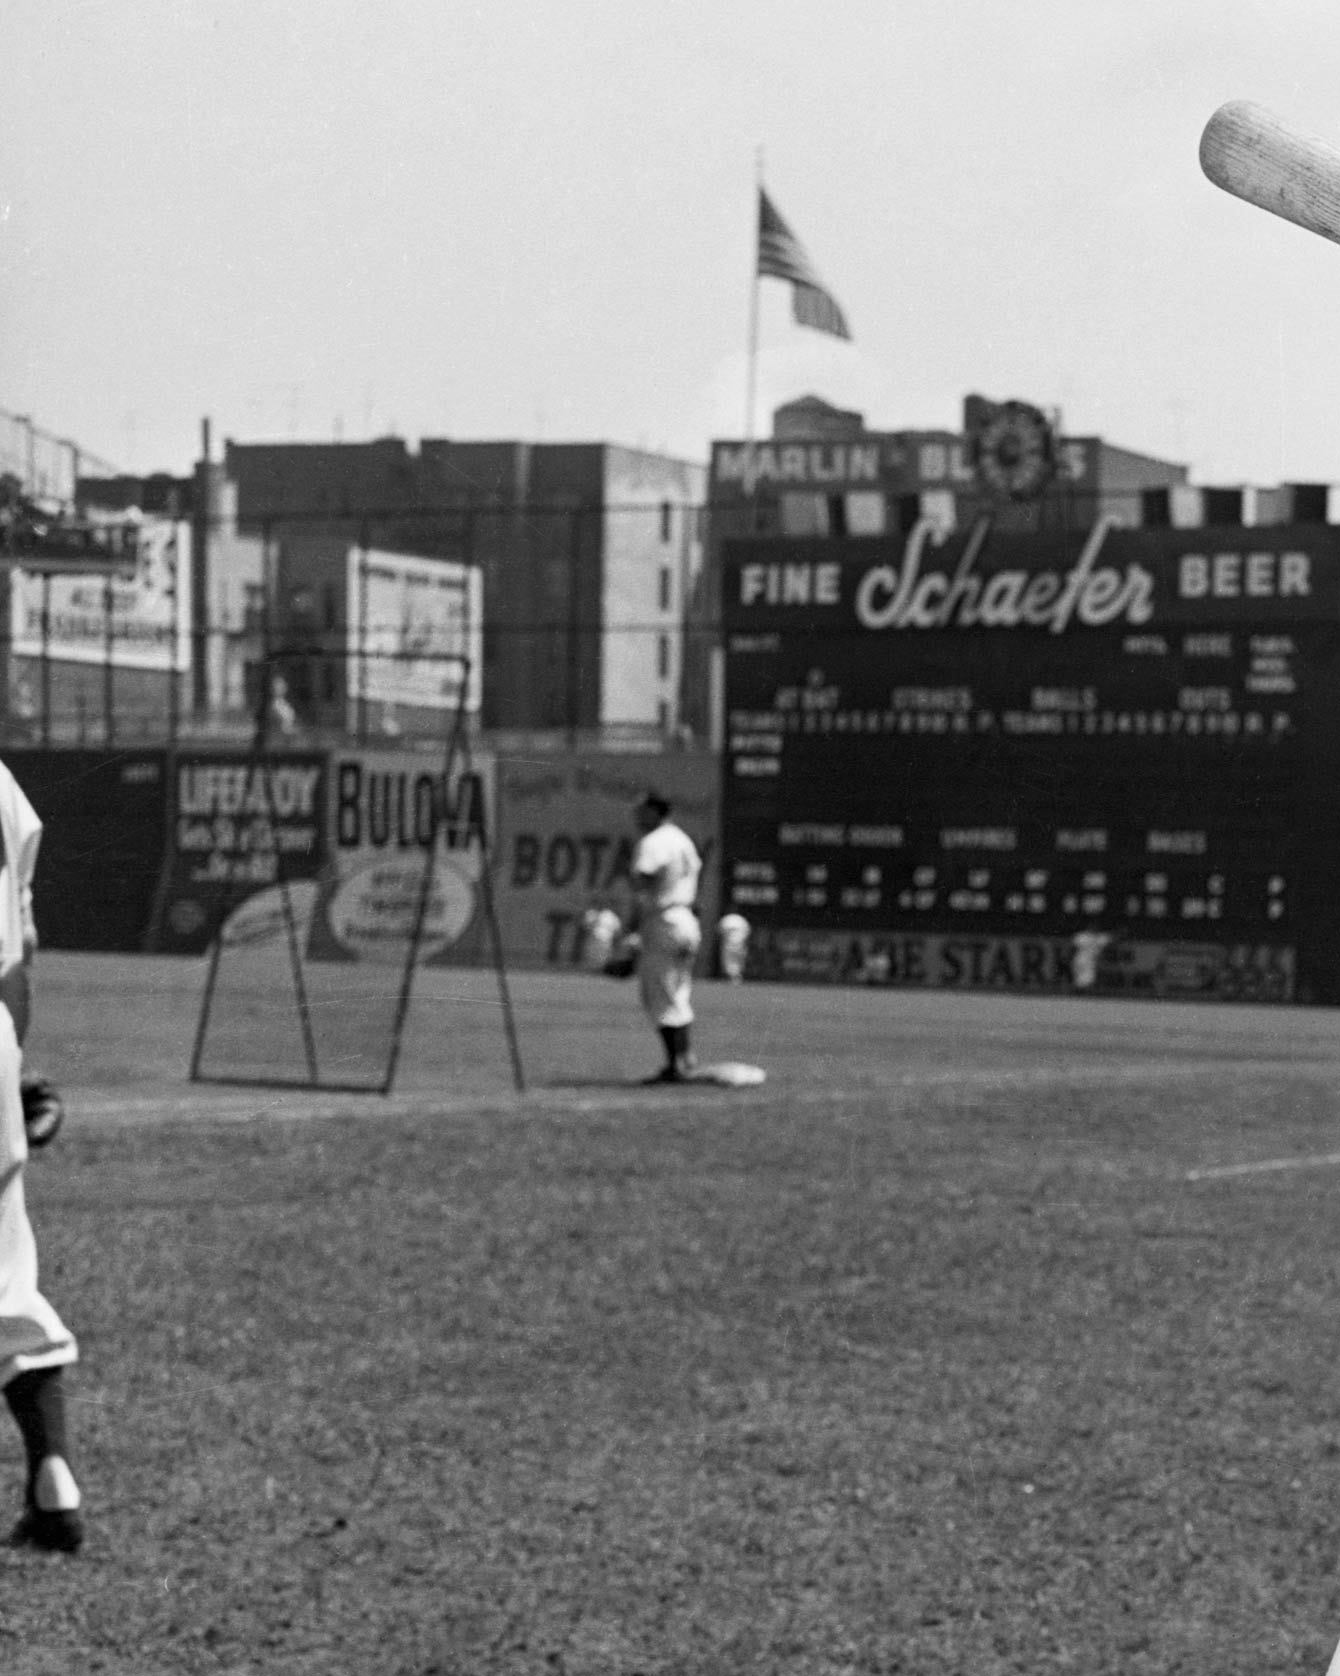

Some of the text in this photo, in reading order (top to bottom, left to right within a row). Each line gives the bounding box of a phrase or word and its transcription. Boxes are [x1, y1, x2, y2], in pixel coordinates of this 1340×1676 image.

[717, 445, 880, 482] MARLIN
[740, 514, 1311, 634] FINE Schaefer BEER
